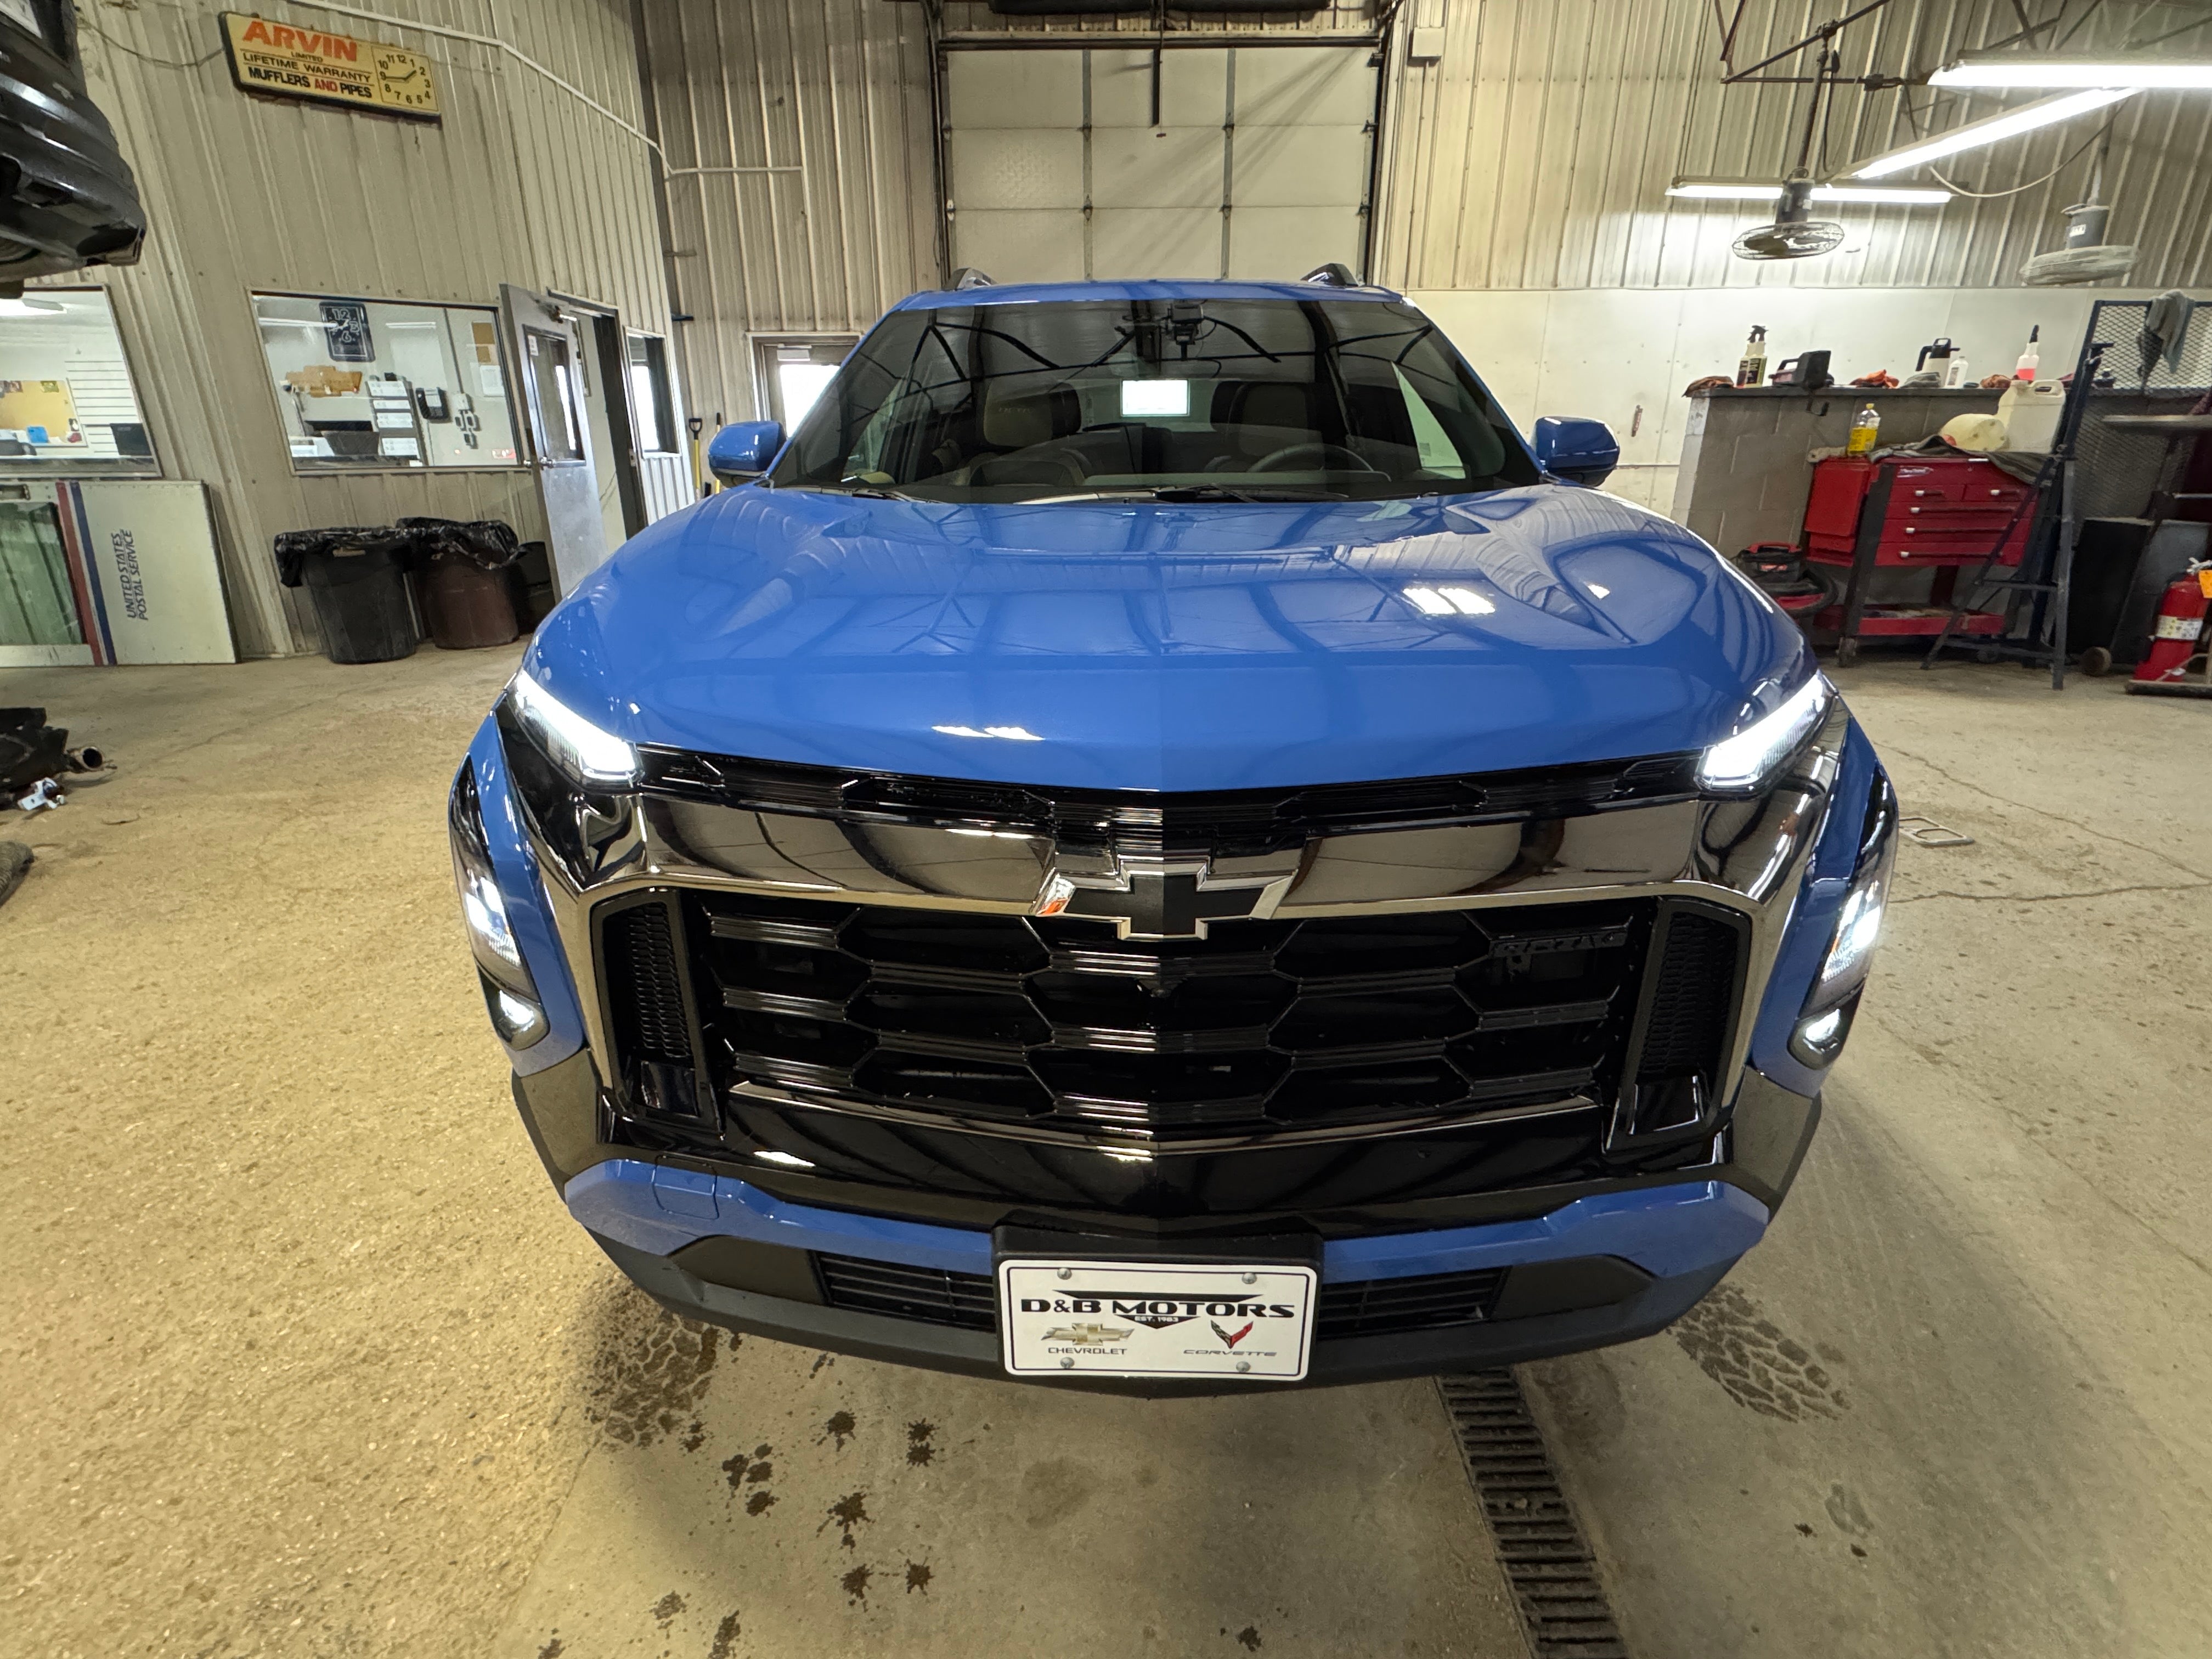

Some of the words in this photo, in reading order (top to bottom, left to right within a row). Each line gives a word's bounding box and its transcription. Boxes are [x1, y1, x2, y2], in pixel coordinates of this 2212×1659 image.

[242, 21, 357, 61] ARVIN
[291, 51, 323, 63] LIMITED
[386, 54, 395, 64] 11
[396, 54, 407, 64] 12
[243, 52, 299, 70] LIFETIME
[303, 63, 370, 82] WARRANTY
[378, 59, 388, 70] 10
[409, 58, 415, 68] 1
[379, 71, 386, 81] 9
[419, 66, 426, 76] 2
[248, 66, 311, 88] MUFFLERS
[315, 78, 338, 92] AND
[340, 82, 372, 98] PIPES
[424, 79, 431, 88] 3
[385, 83, 391, 93] 8
[394, 91, 401, 100] 7
[406, 94, 412, 104] 6
[425, 91, 431, 100] 4
[332, 308, 351, 320] 12
[341, 330, 352, 343] 6
[111, 533, 129, 573] STATES
[122, 529, 140, 577] SERVICE
[120, 574, 137, 619] UNITED
[133, 578, 149, 621] POSTAL
[1021, 1299, 1102, 1313] D&B
[1113, 1300, 1295, 1318] MOTORS
